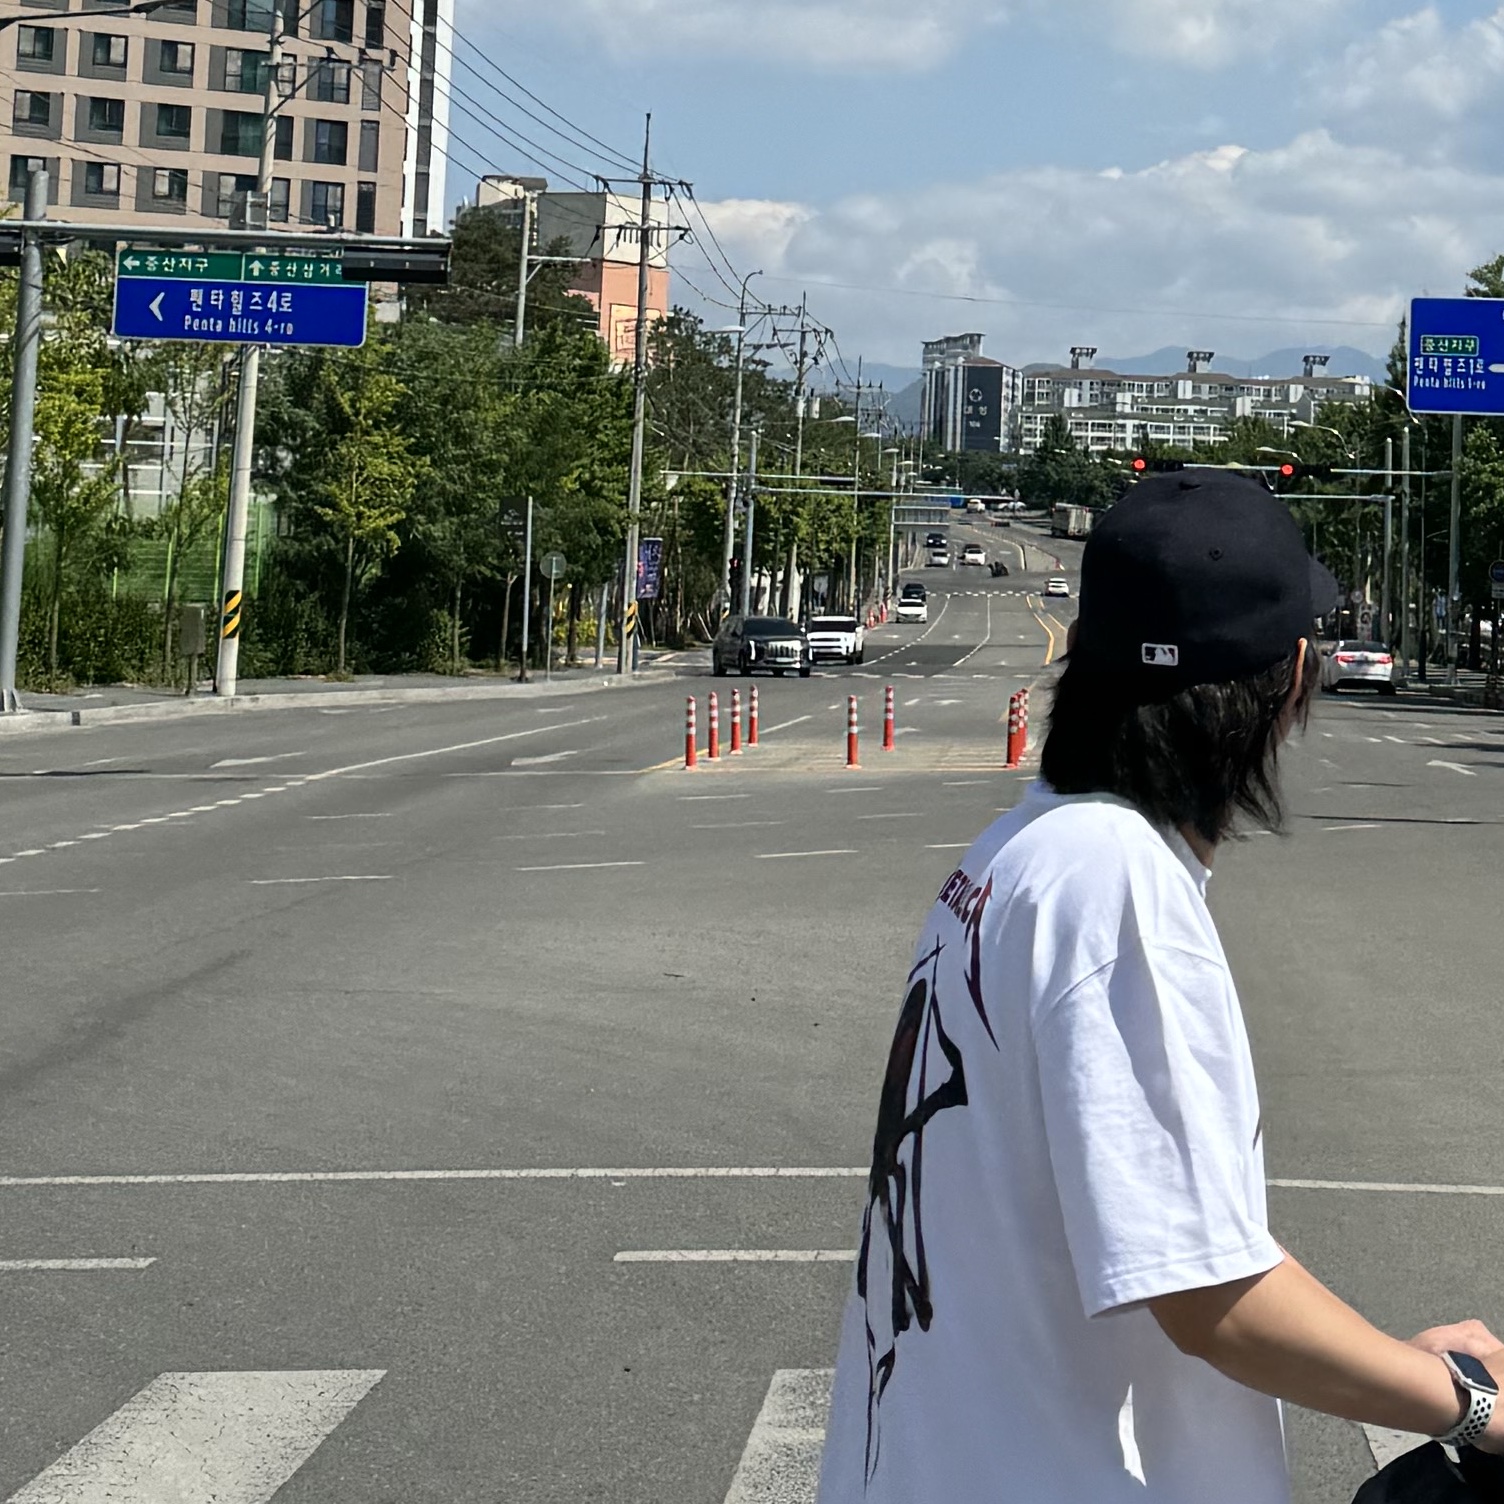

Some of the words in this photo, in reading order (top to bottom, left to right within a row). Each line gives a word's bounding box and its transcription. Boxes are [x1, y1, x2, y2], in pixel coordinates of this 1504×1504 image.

[190, 289, 293, 315] 펜타힐즈4로
[184, 315, 222, 332] Penta
[229, 317, 259, 334] hills
[265, 319, 293, 335] 4-ro
